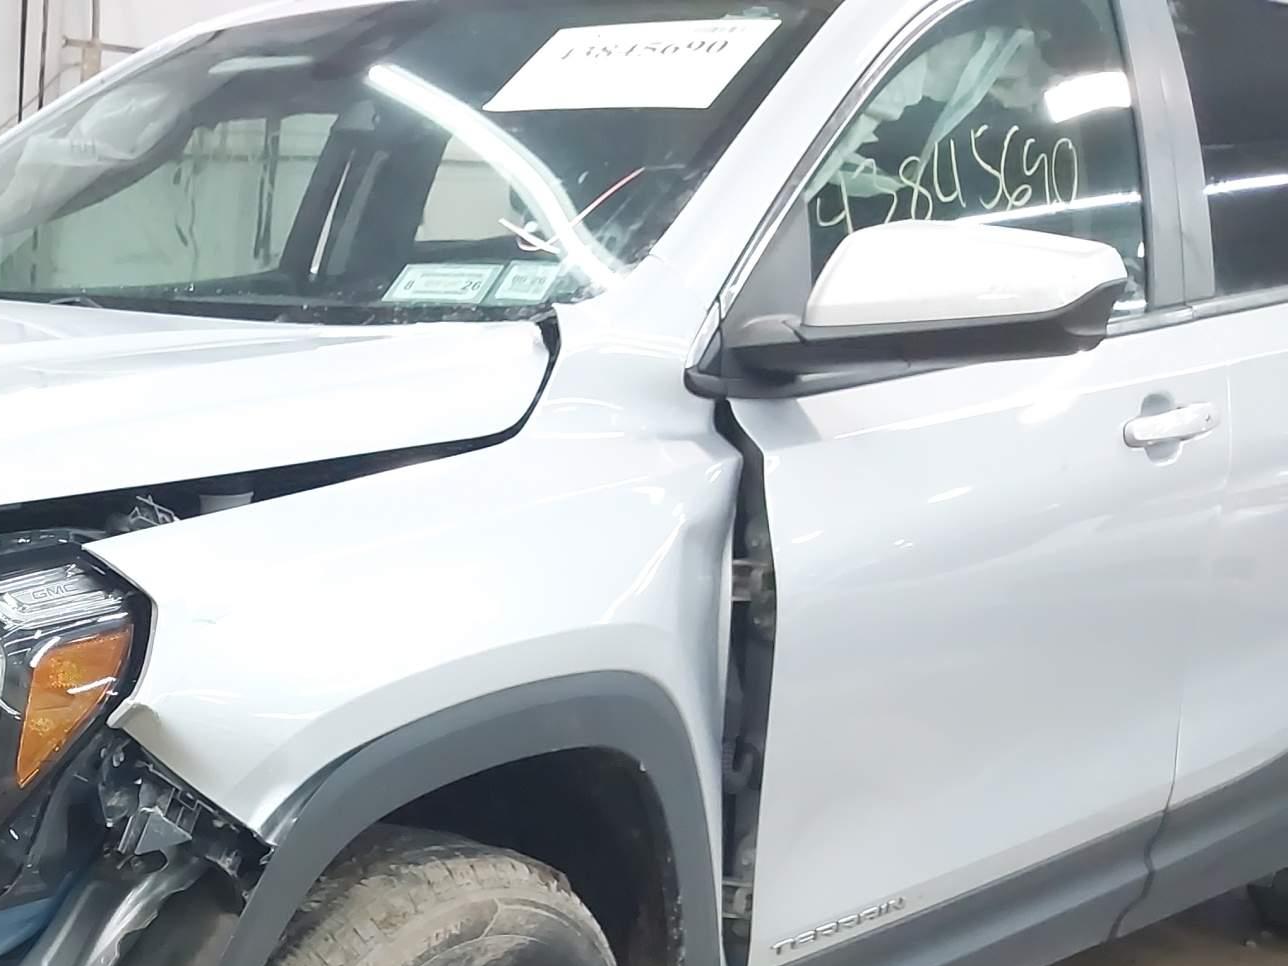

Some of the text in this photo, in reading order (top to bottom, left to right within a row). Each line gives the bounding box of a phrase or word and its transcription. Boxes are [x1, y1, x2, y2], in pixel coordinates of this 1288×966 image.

[816, 124, 1078, 234] 43845690
[31, 582, 79, 600] GMC
[770, 896, 905, 956] TERRAIN
